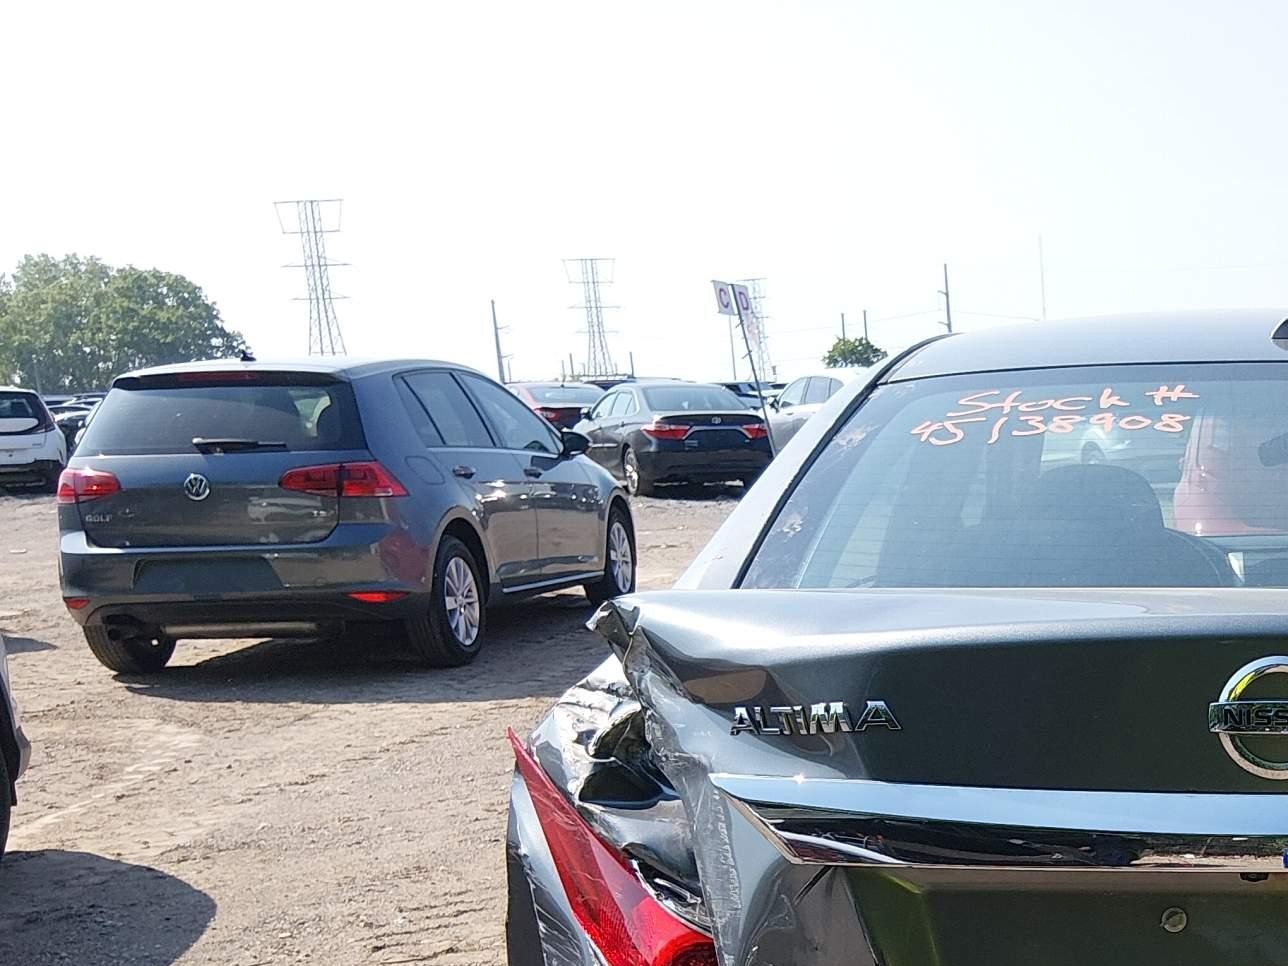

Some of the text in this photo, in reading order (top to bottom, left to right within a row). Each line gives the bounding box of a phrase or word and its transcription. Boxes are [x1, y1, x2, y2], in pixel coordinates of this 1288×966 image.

[718, 287, 730, 309] C
[738, 291, 750, 311] D
[946, 384, 1200, 417] Stock #
[730, 700, 902, 736] ALTIMA
